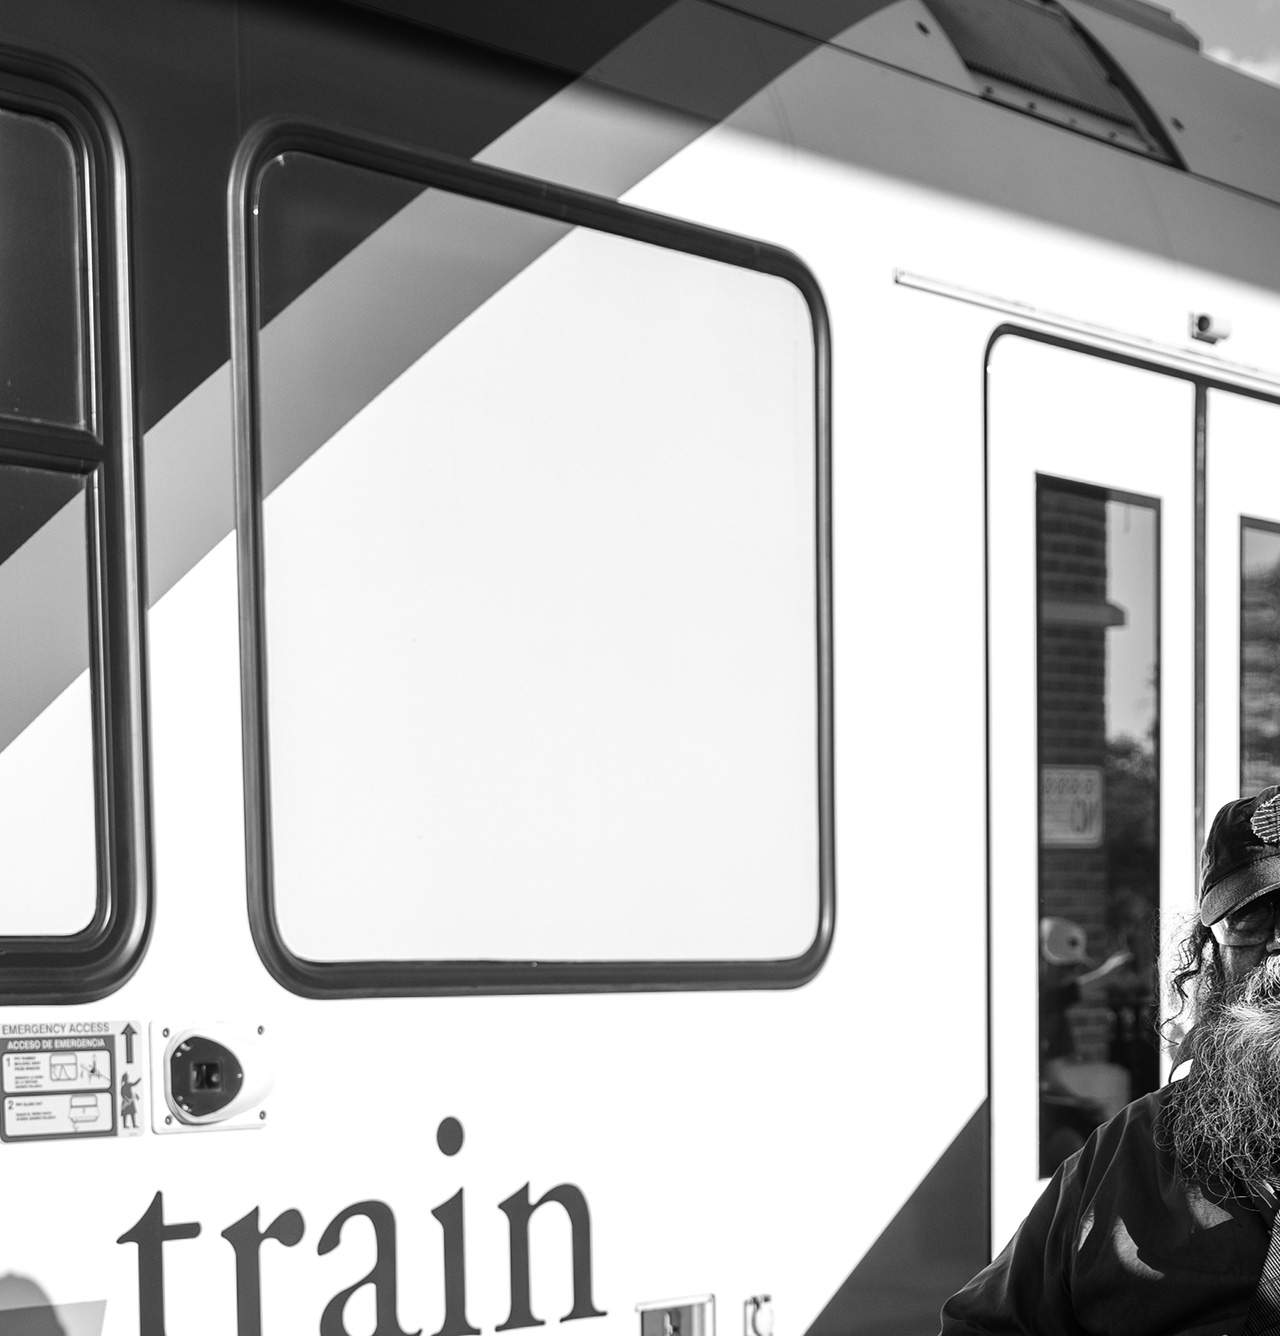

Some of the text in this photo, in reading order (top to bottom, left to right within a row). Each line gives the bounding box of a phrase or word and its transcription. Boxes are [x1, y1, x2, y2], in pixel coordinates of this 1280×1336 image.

[2, 1021, 110, 1035] EMERGENCY ACCESS
[7, 1037, 106, 1050] ACCESO DE EMERGENCIA
